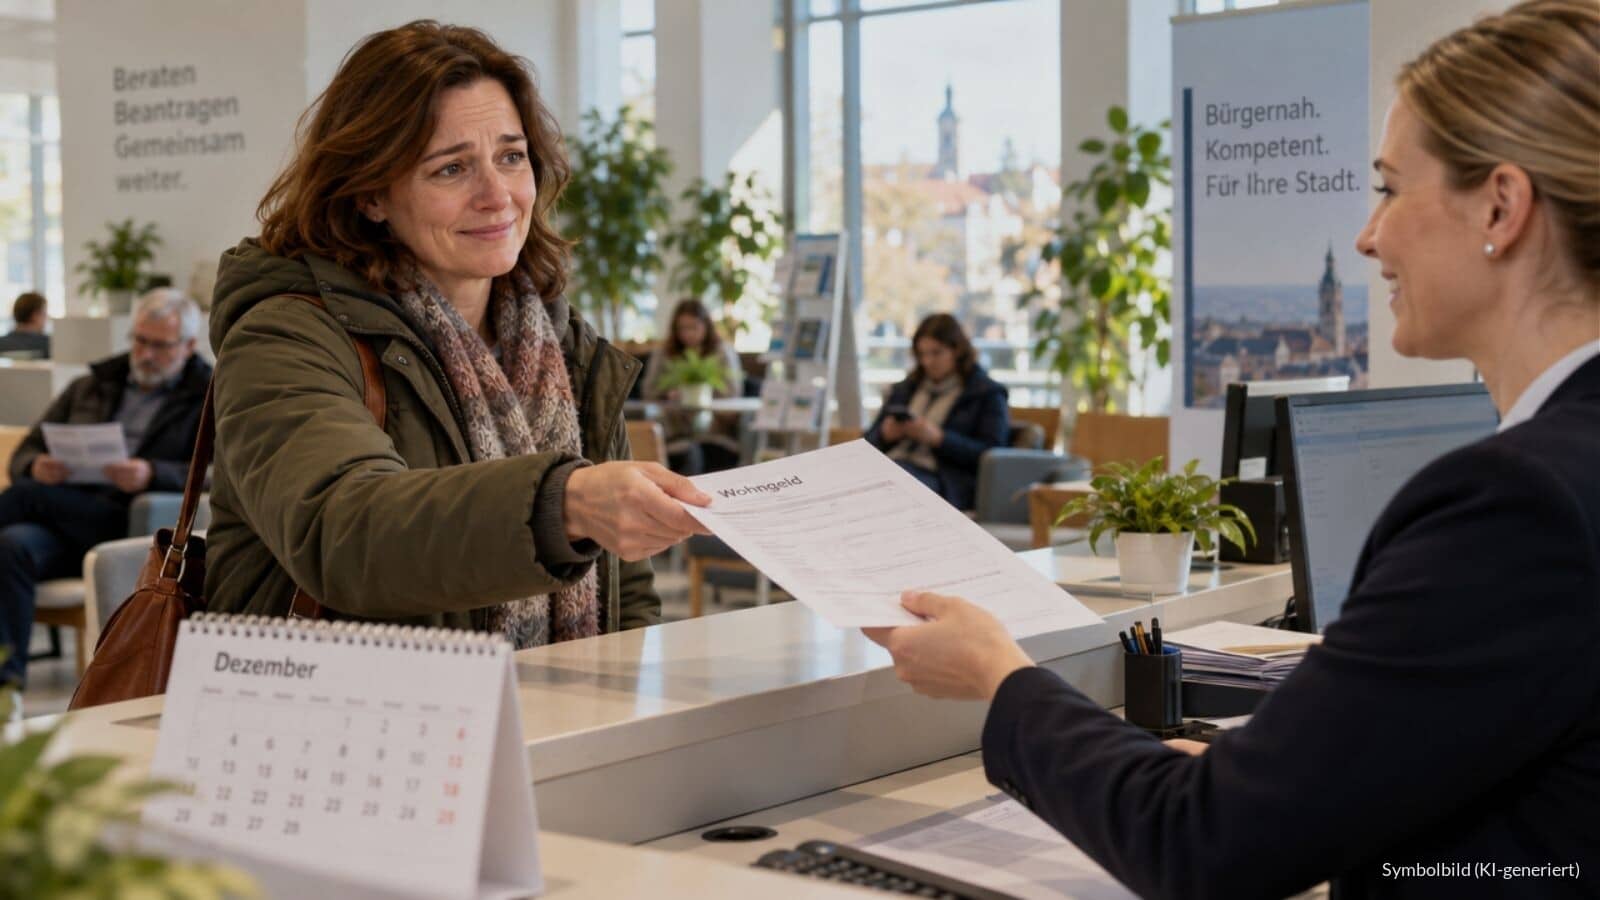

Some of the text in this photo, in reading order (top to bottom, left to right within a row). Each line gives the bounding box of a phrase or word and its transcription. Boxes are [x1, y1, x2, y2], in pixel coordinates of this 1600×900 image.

[113, 65, 197, 93] Beraten
[114, 95, 240, 125] Beantragen
[1206, 95, 1321, 129] Bürgernah.
[114, 128, 246, 160] Gemeinsam
[1206, 134, 1330, 165] Kompetent.
[1206, 167, 1361, 199] Für Ihre Stadt.
[716, 475, 804, 499] Wohngeld
[214, 651, 318, 680] Dezember
